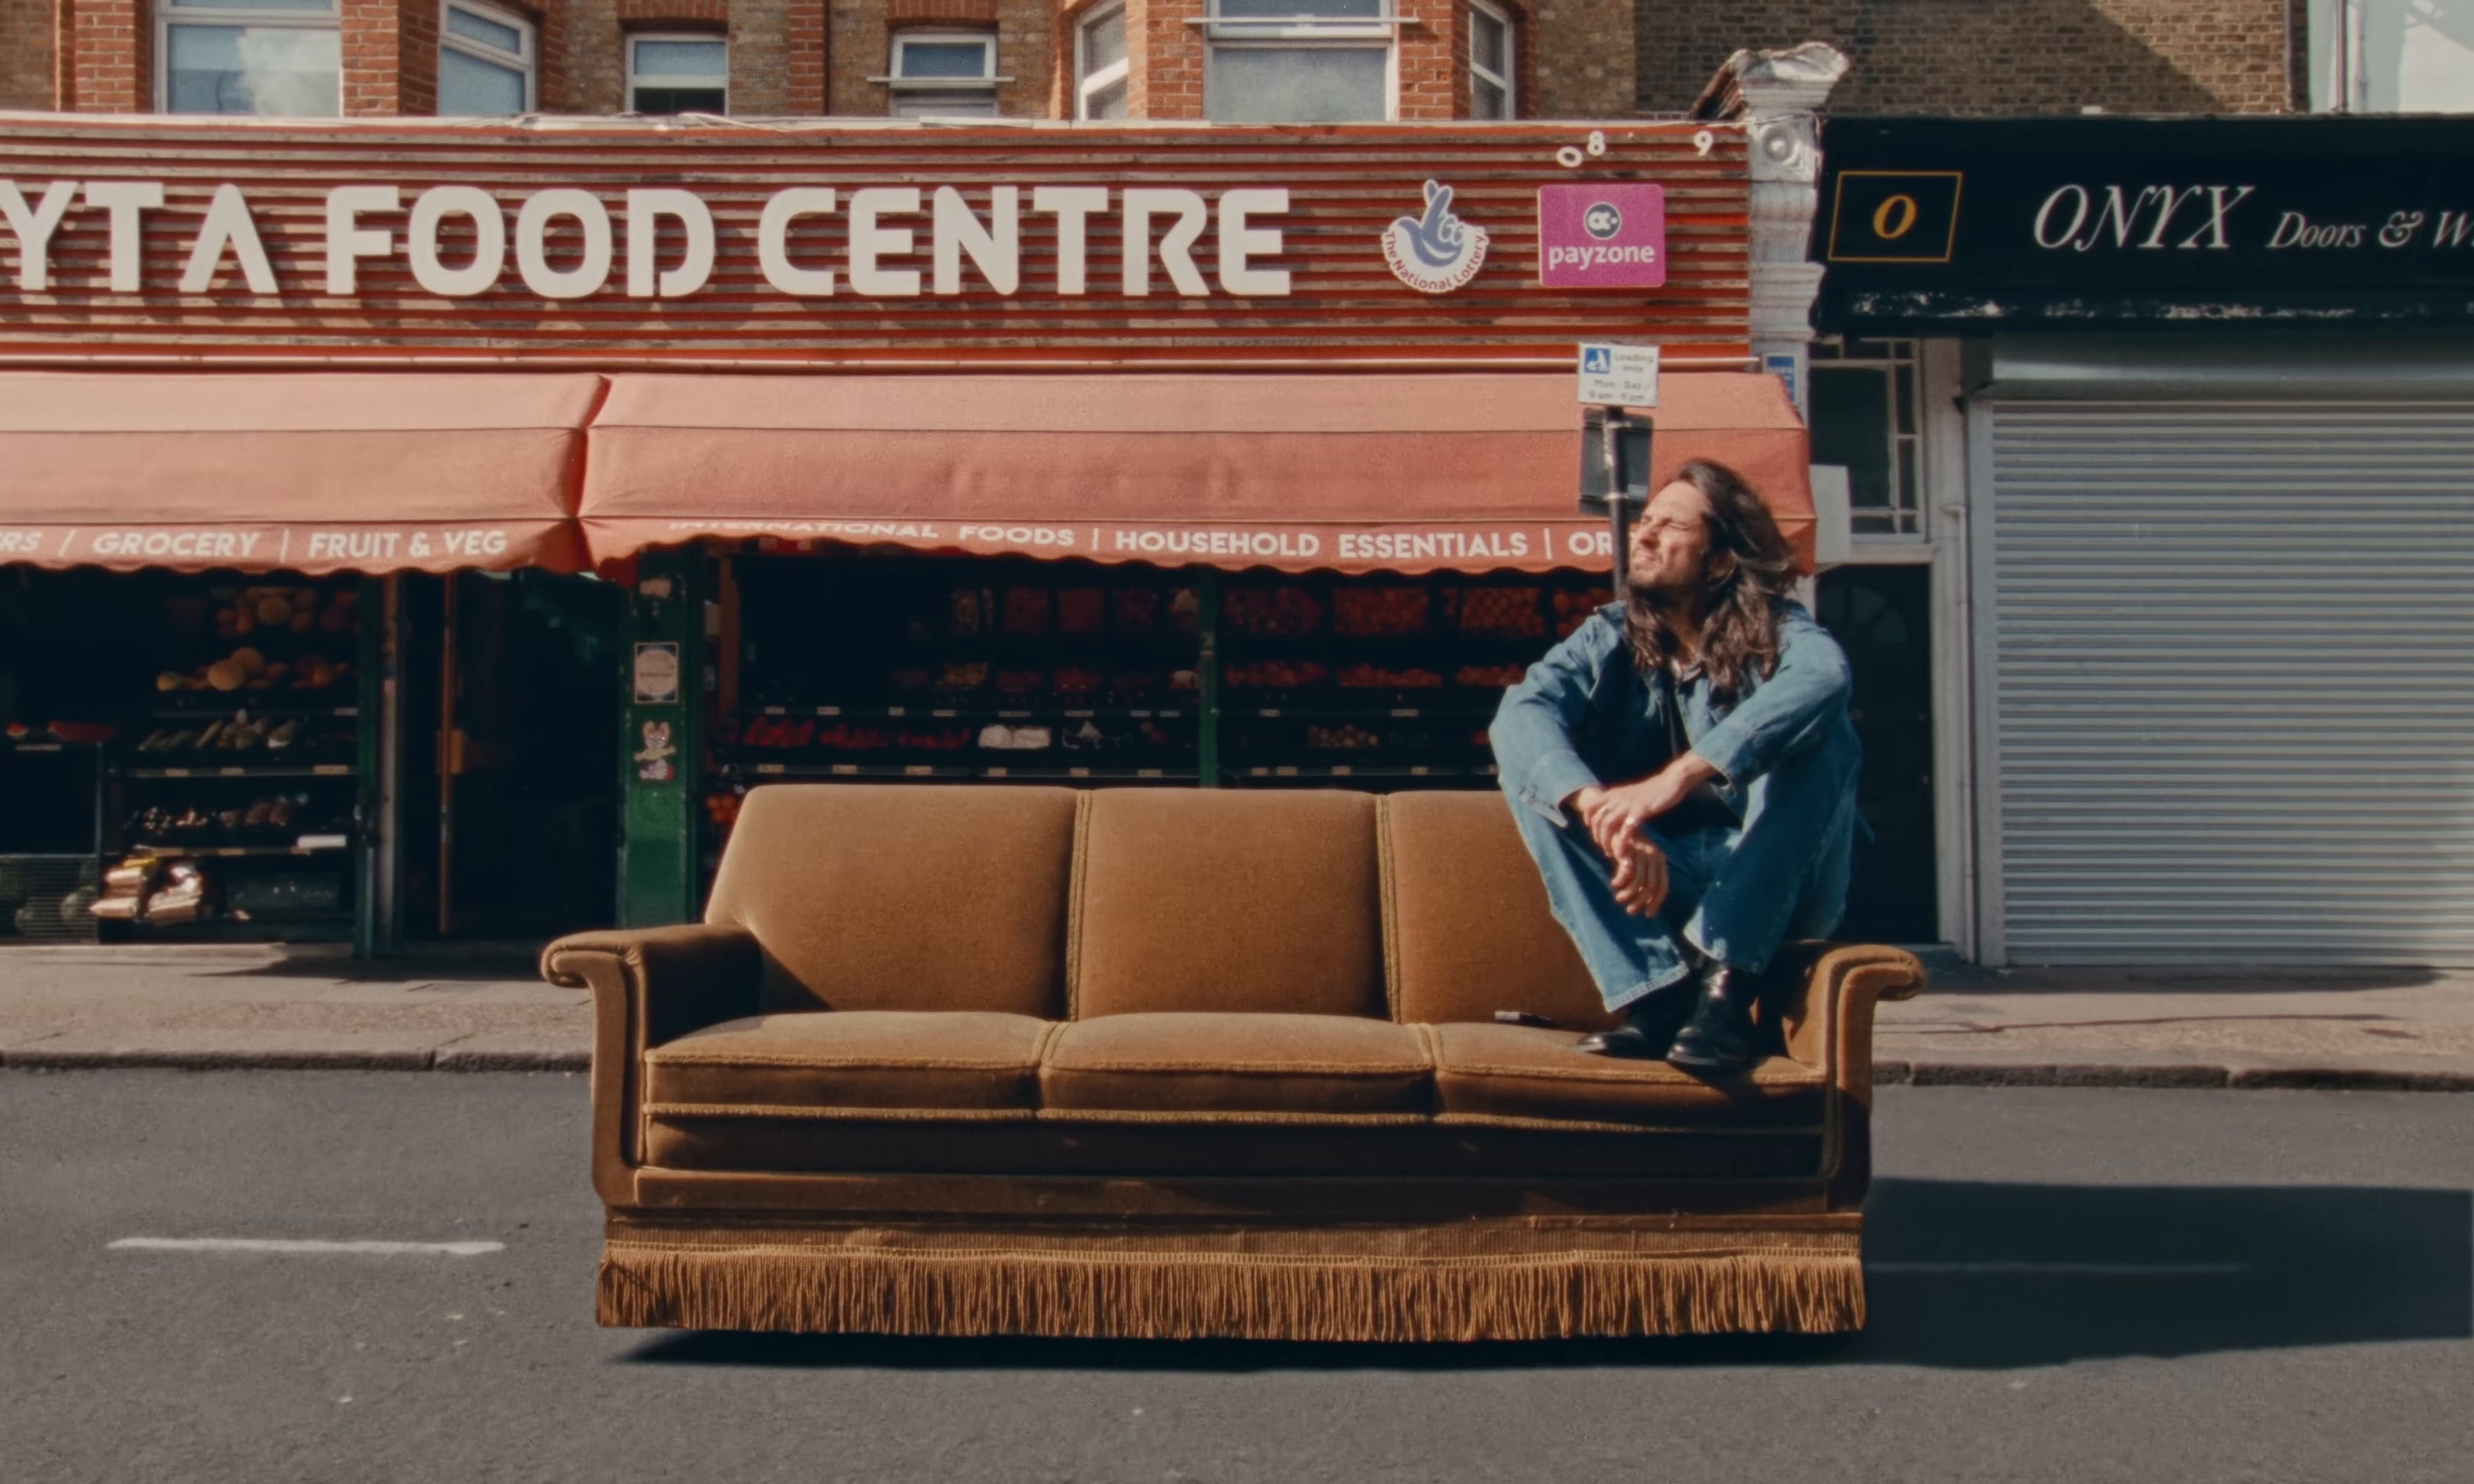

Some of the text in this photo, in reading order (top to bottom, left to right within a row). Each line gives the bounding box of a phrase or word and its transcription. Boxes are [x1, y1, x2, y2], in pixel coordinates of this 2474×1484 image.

[2033, 183, 2474, 251] ONYX Doors & W
[326, 186, 715, 298] FOOD
[757, 186, 1291, 296] CENTRE
[1385, 231, 1486, 290] The National Lottery
[1548, 245, 1655, 271] payzone
[0, 530, 508, 558] RS GROCERY FRUIT & VEG
[959, 525, 1075, 546] FOODS
[1115, 530, 1320, 557] HOUSEHOLD
[1338, 531, 1528, 559] ESSENTIALS
[1568, 530, 1613, 556] OR
